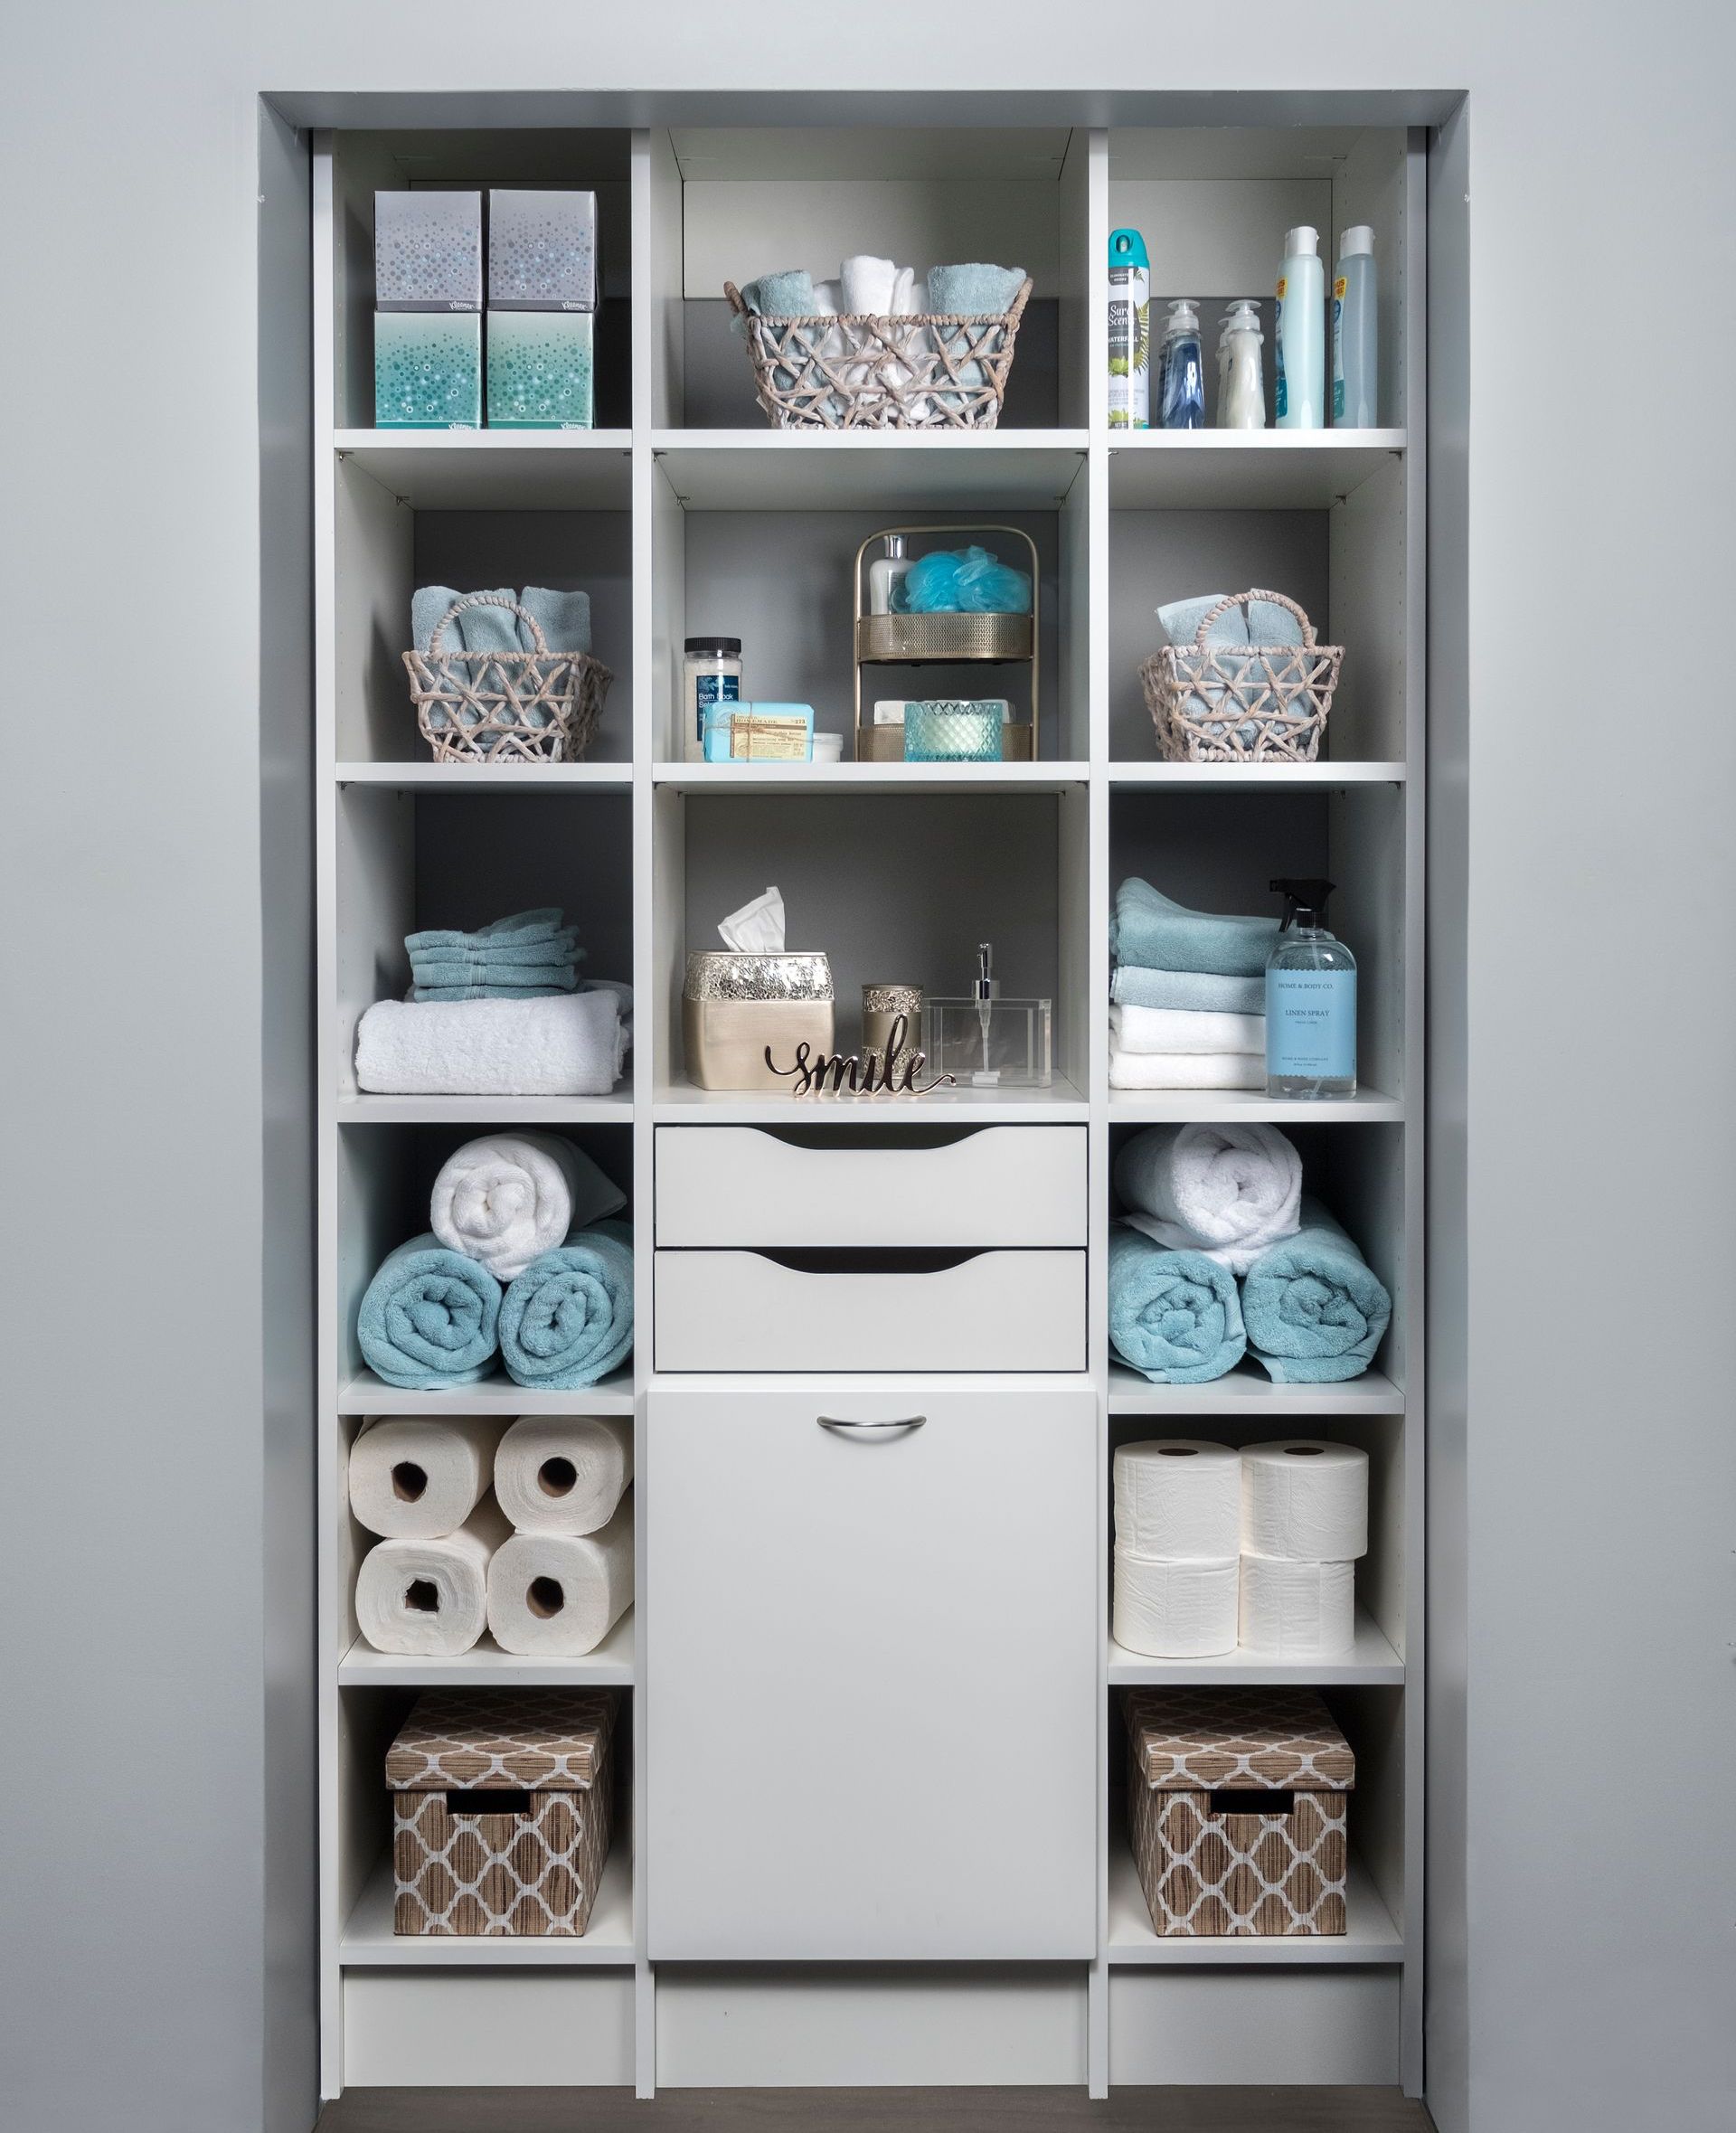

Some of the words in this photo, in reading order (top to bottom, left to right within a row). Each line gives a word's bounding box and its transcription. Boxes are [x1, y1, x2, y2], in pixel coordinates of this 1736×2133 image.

[449, 300, 476, 310] Kleenex
[561, 300, 588, 310] Kleenex
[765, 1013, 957, 1098] smile
